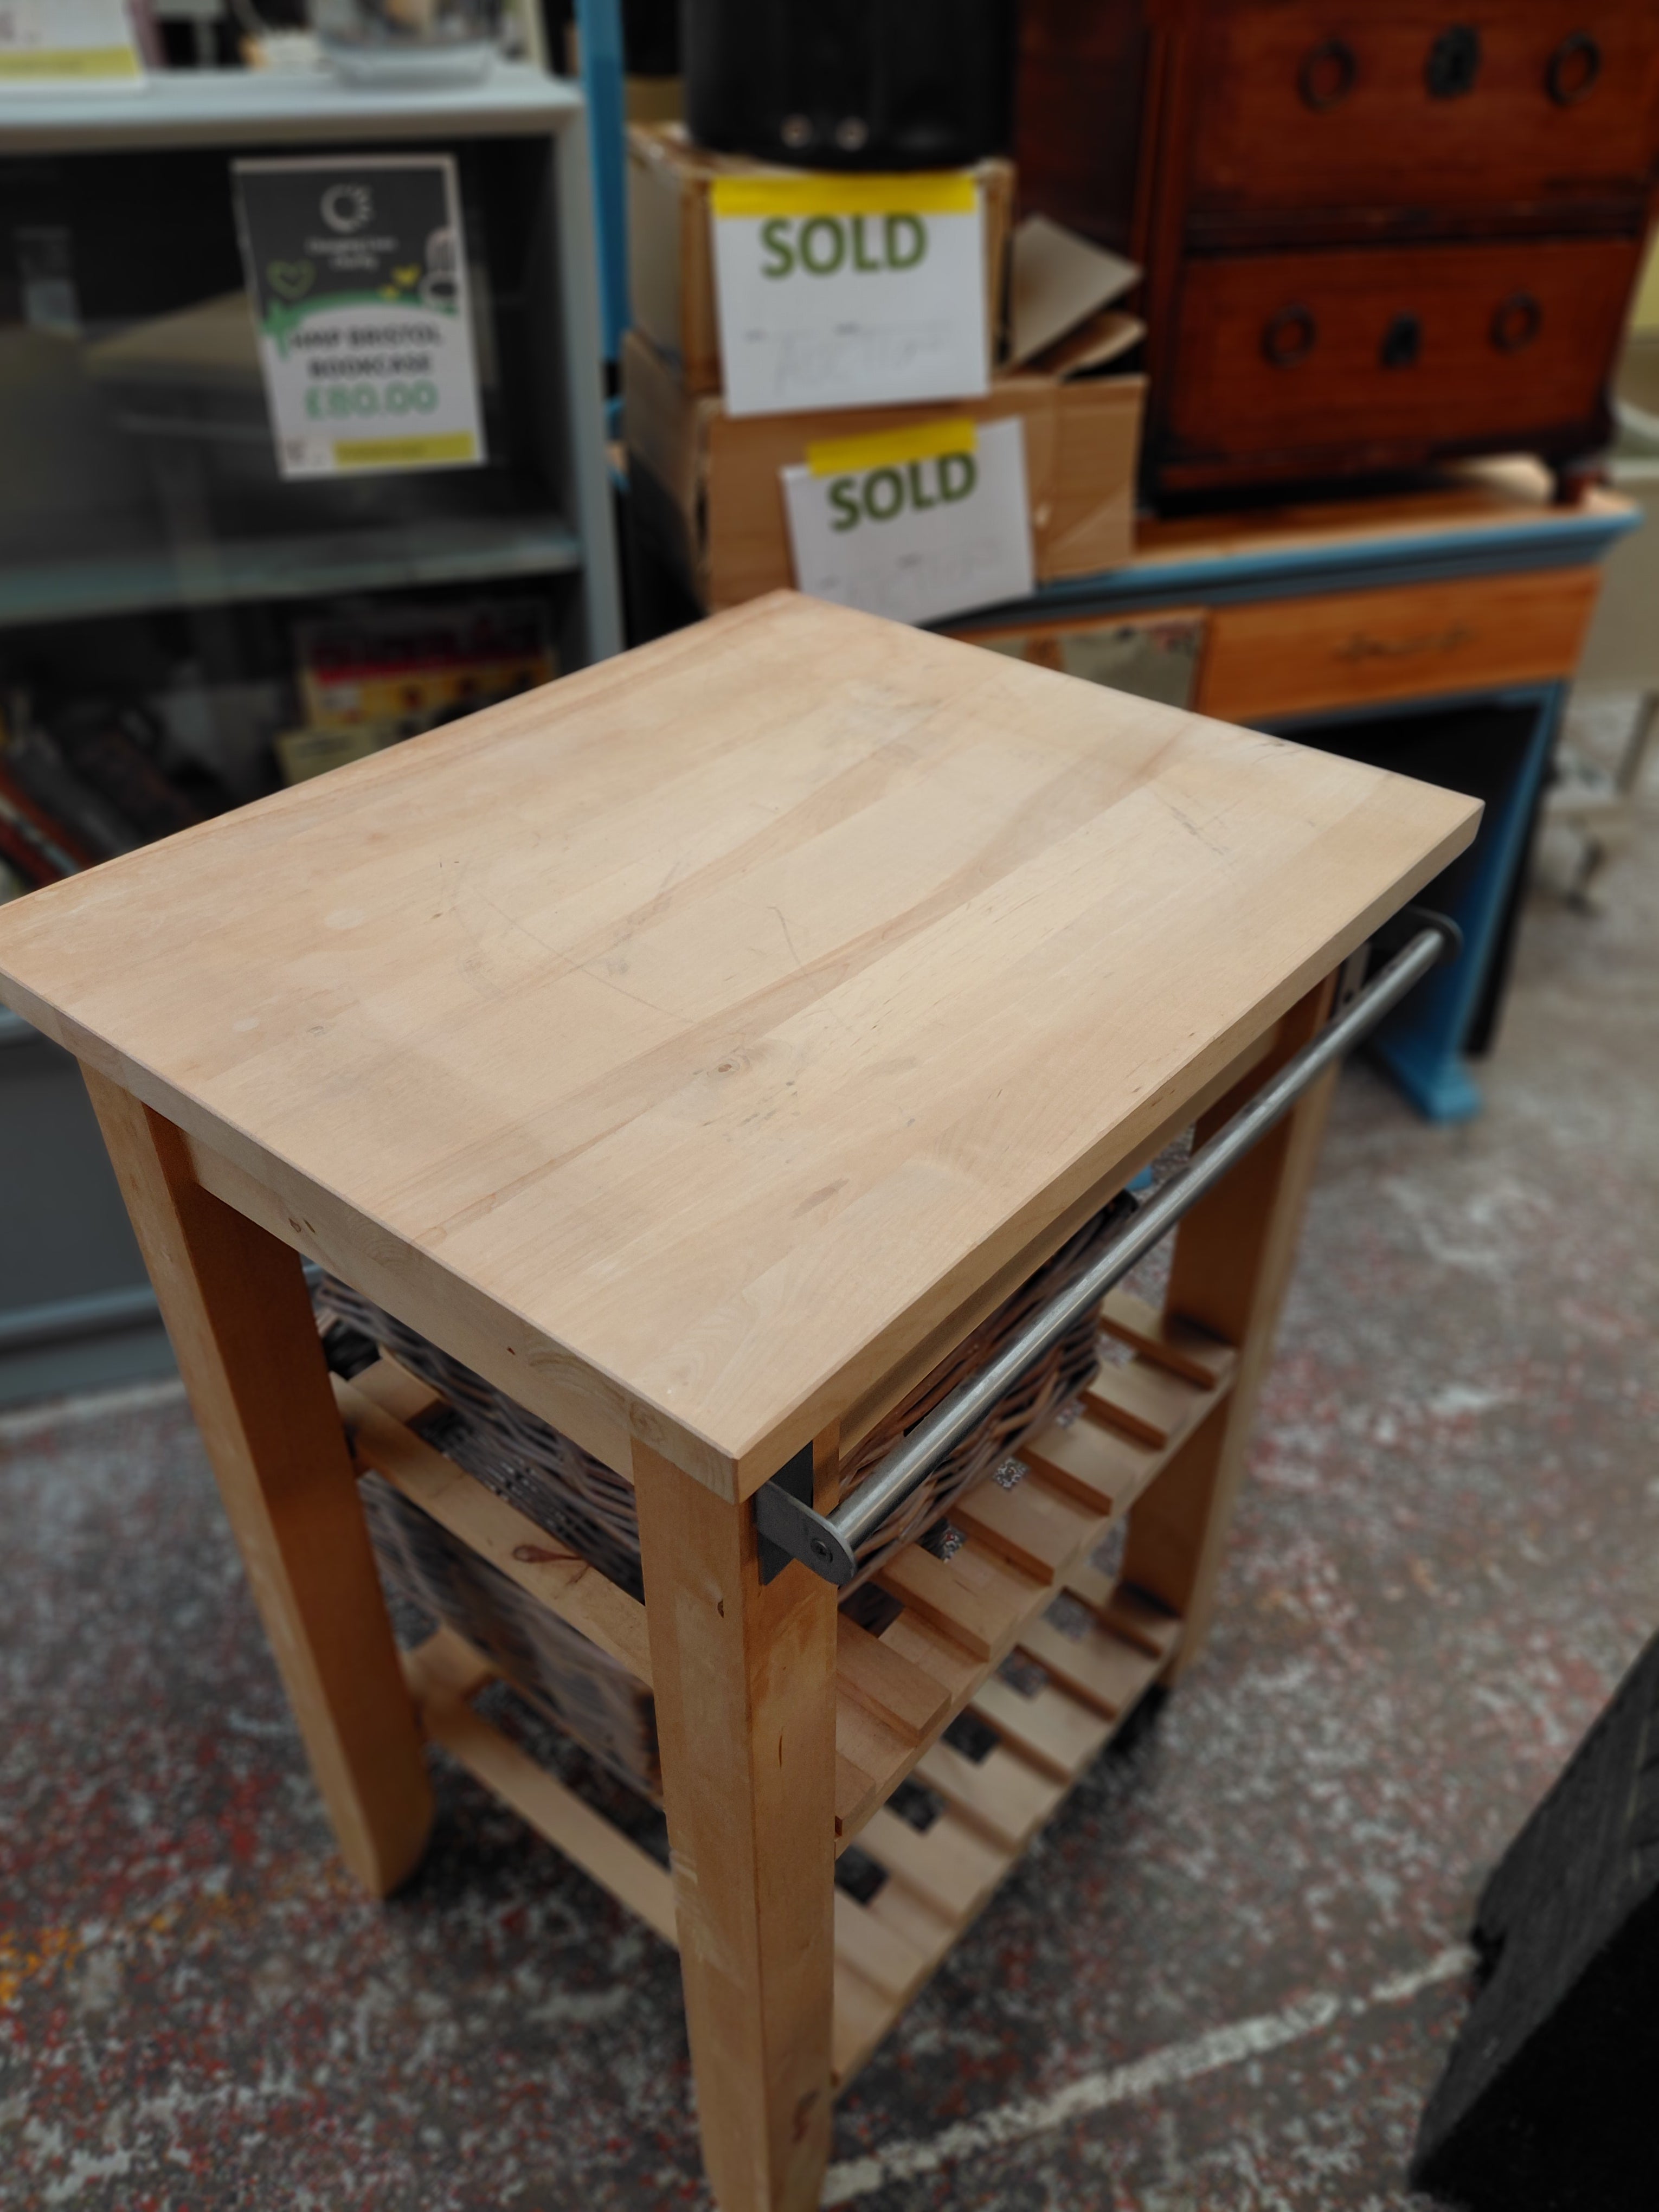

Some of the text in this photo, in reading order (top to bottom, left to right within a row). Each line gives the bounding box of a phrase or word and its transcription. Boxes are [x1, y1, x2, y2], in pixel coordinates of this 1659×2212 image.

[761, 213, 928, 279] SOLD
[309, 353, 431, 379] BOOKCASE
[827, 450, 978, 532] SOLD
